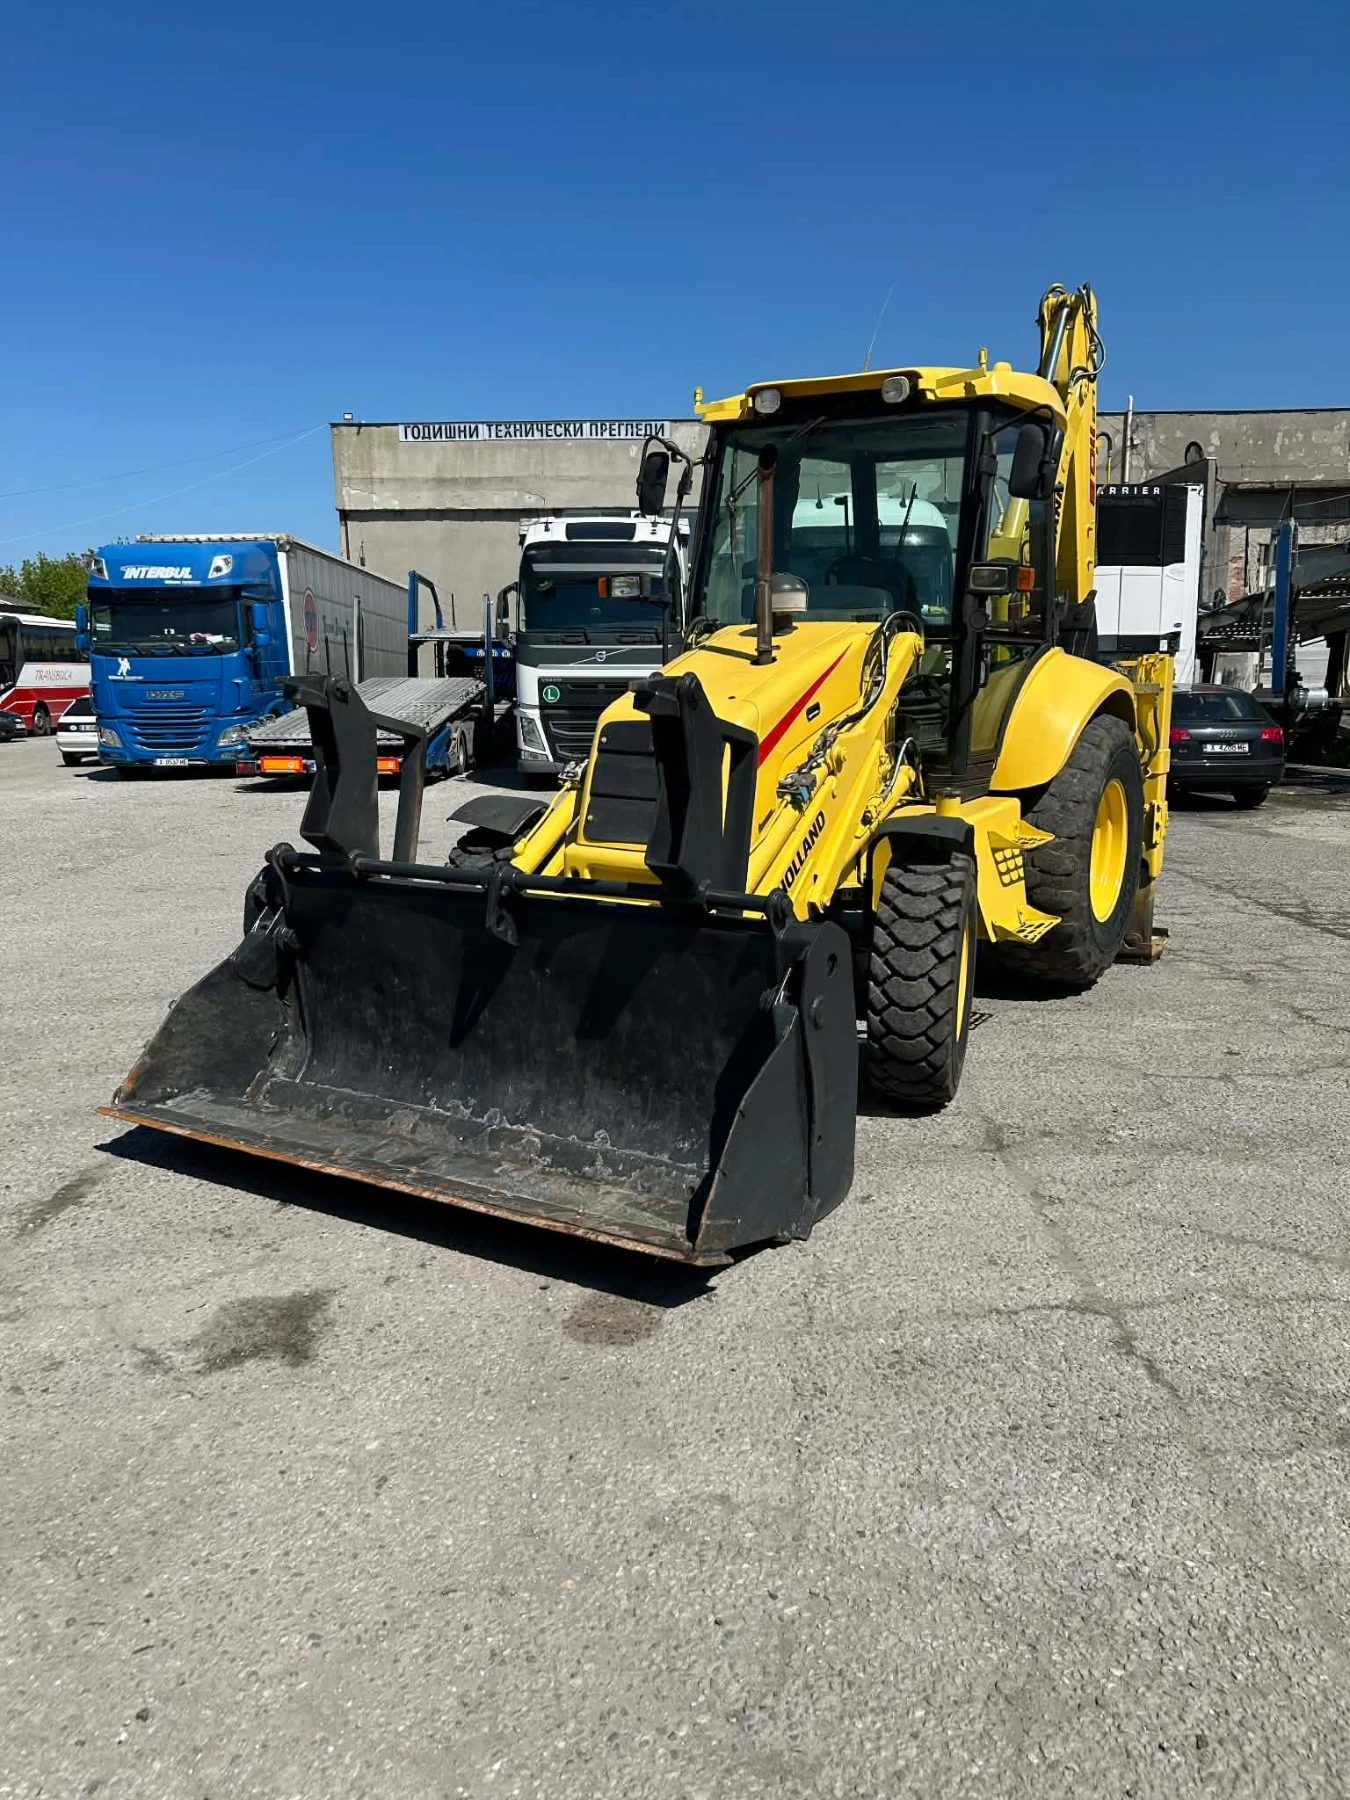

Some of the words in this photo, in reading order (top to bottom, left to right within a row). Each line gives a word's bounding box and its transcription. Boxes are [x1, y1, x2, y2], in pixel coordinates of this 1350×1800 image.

[403, 425, 480, 440] ГОДИШНИ
[485, 423, 584, 439] ТЕХНИЧЕСКИ
[589, 423, 665, 438] ПРЕГЛЕДИ
[1096, 486, 1161, 495] ARRIER
[122, 566, 193, 580] INTERBUL
[146, 690, 185, 700] DAF
